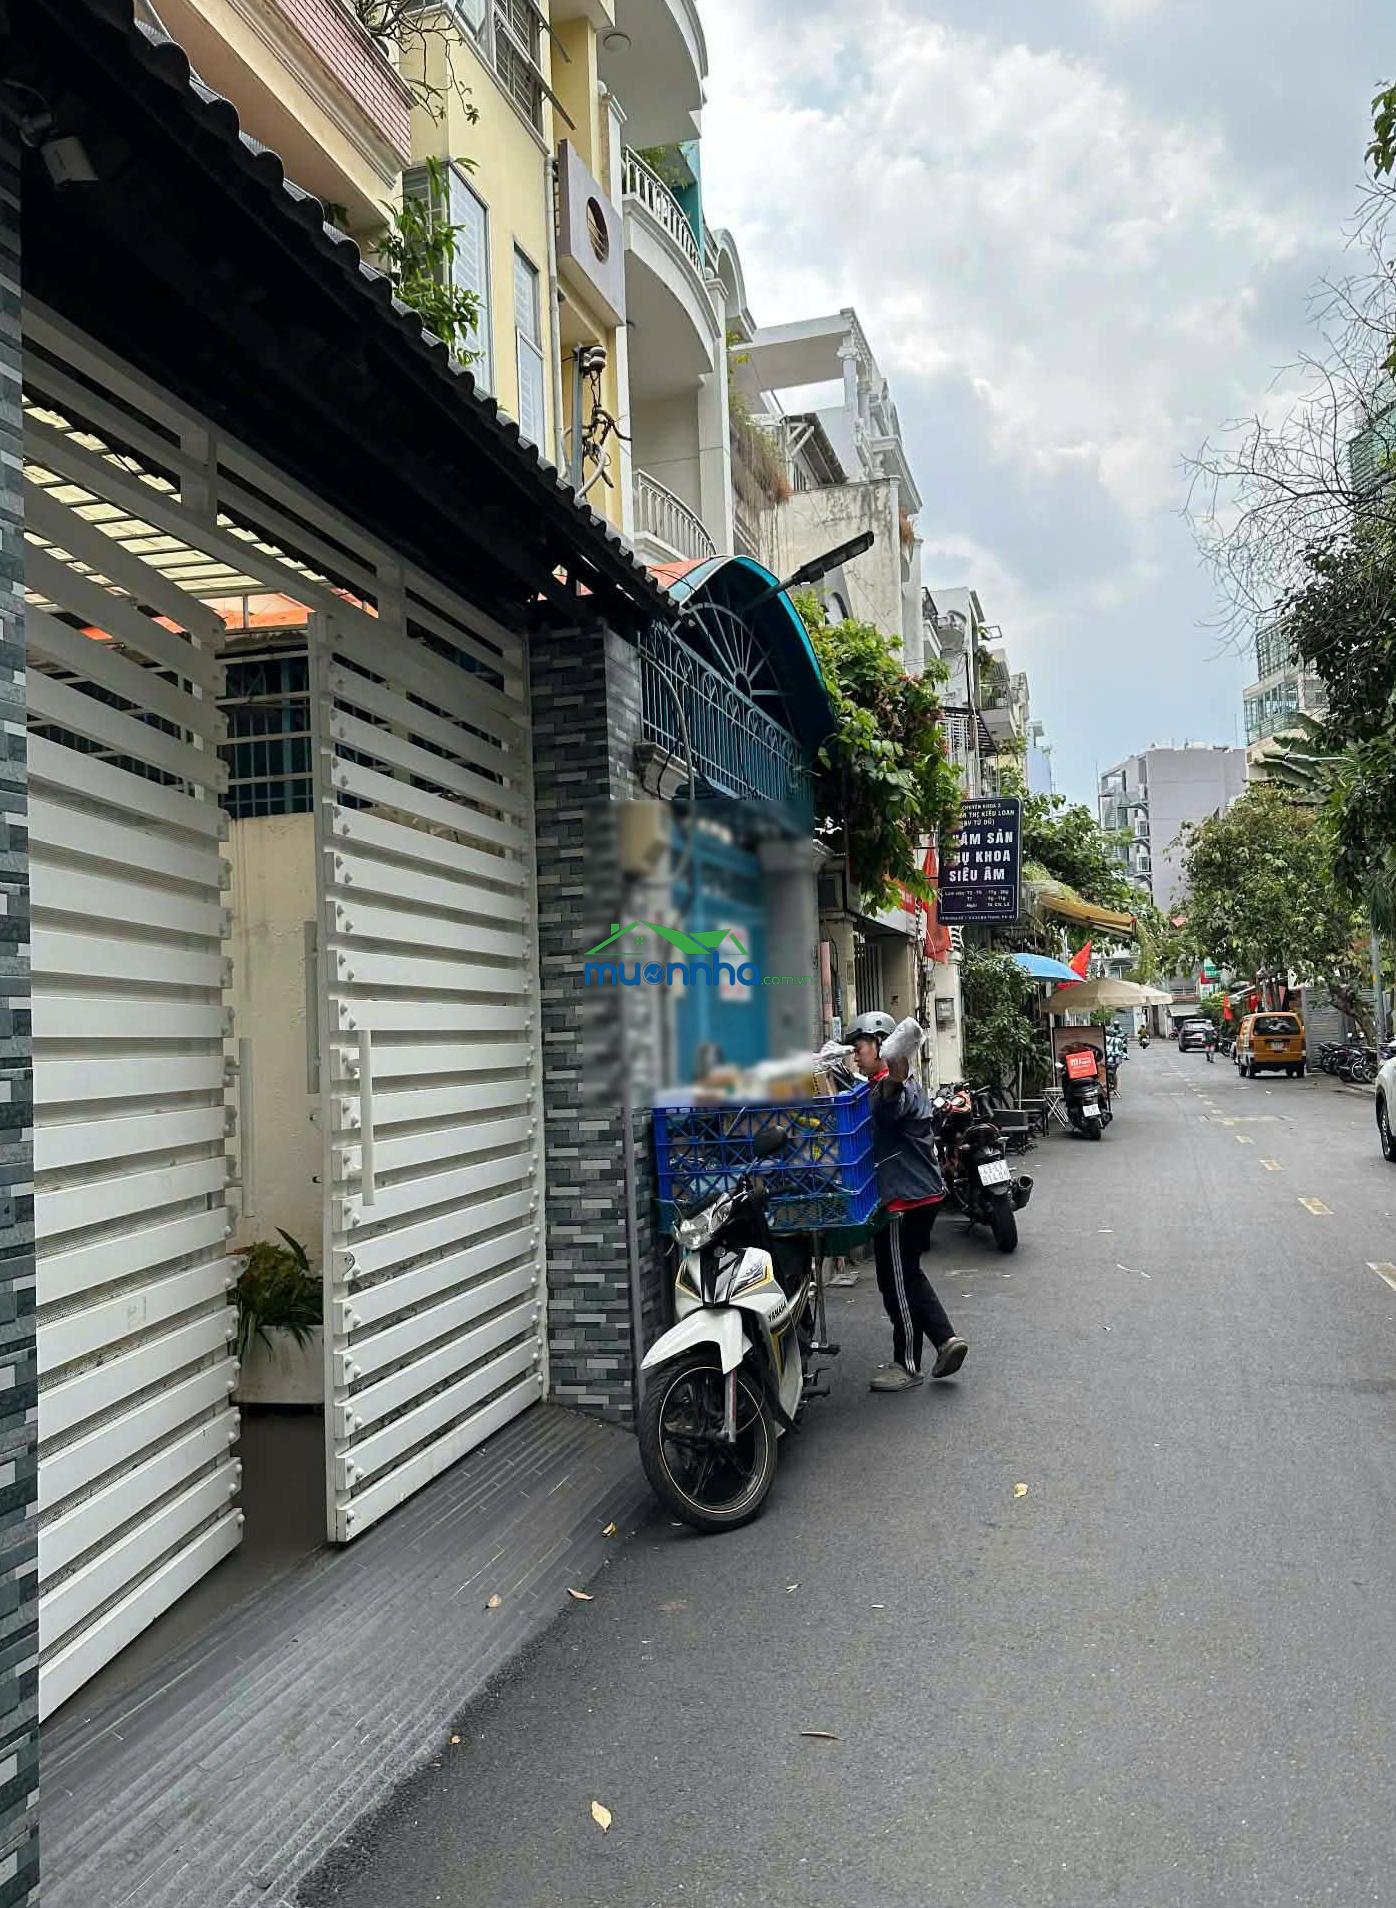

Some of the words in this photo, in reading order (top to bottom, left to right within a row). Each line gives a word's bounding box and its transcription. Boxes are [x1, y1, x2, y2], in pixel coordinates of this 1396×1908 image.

[987, 828, 1013, 844] SẢN
[975, 850, 1011, 863] KHOA
[949, 867, 978, 883] SIÊU
[984, 866, 1005, 881] ÂM
